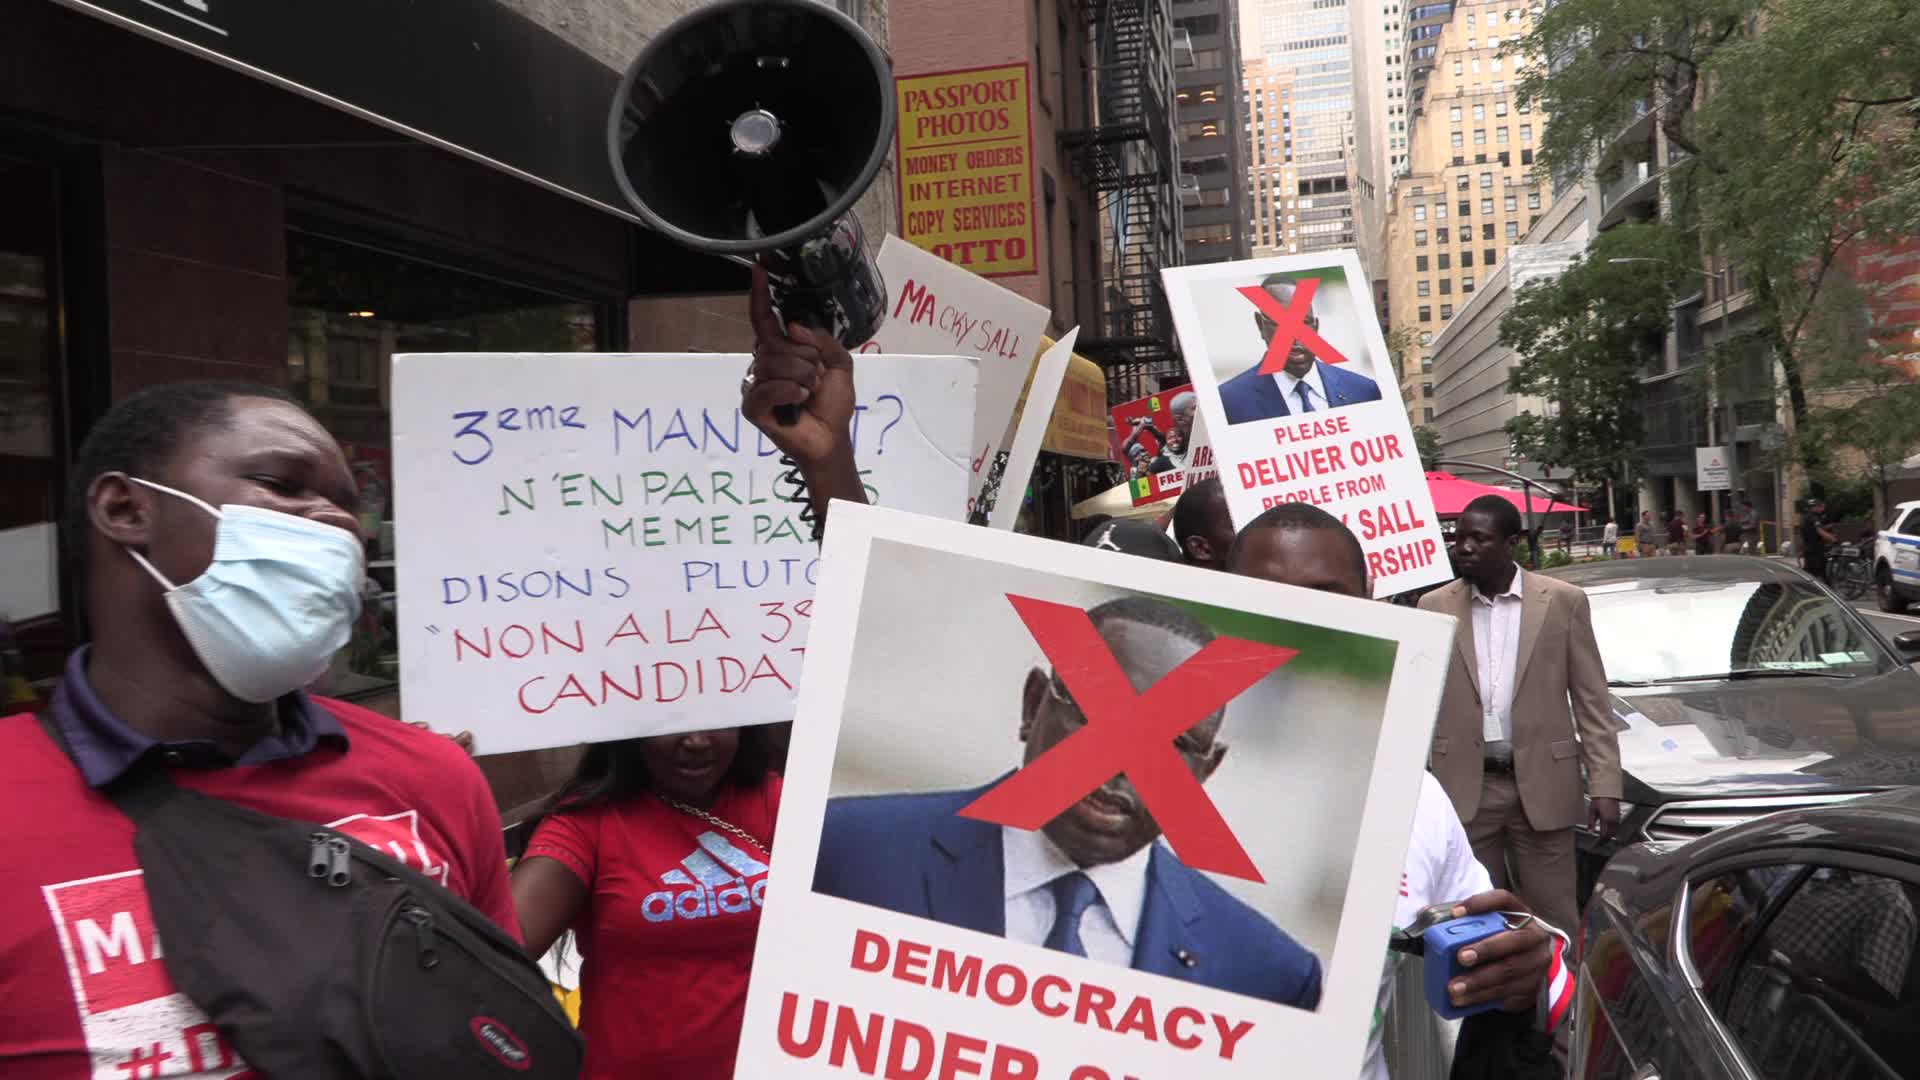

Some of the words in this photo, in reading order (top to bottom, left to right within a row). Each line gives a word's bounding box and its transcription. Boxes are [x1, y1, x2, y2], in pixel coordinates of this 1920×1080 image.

[904, 79, 1020, 112] PASSPORT
[917, 107, 1010, 138] PHOTOS
[906, 152, 958, 176] MONEY
[967, 146, 1024, 170] ORDERS
[909, 173, 1023, 201] INTERNET
[908, 209, 945, 236] COPY
[953, 202, 1025, 233] SERVICES
[932, 237, 1026, 264] OTTO
[975, 320, 1020, 358] SALL
[612, 395, 904, 457] MANT?
[1274, 416, 1350, 445] PLEASE
[1160, 471, 1184, 486] FRE
[1237, 445, 1346, 490] DELIVER
[1350, 434, 1403, 467] OUR
[1336, 474, 1386, 500] FROM
[601, 515, 732, 549] MEME
[1358, 499, 1425, 541] SALL
[1367, 538, 1437, 580] RSHIP
[441, 567, 631, 605] DISONS
[605, 613, 650, 647] A
[666, 606, 731, 644] LA
[850, 929, 1255, 1061] DEMOCRACY
[776, 991, 1040, 1080] UNDER
